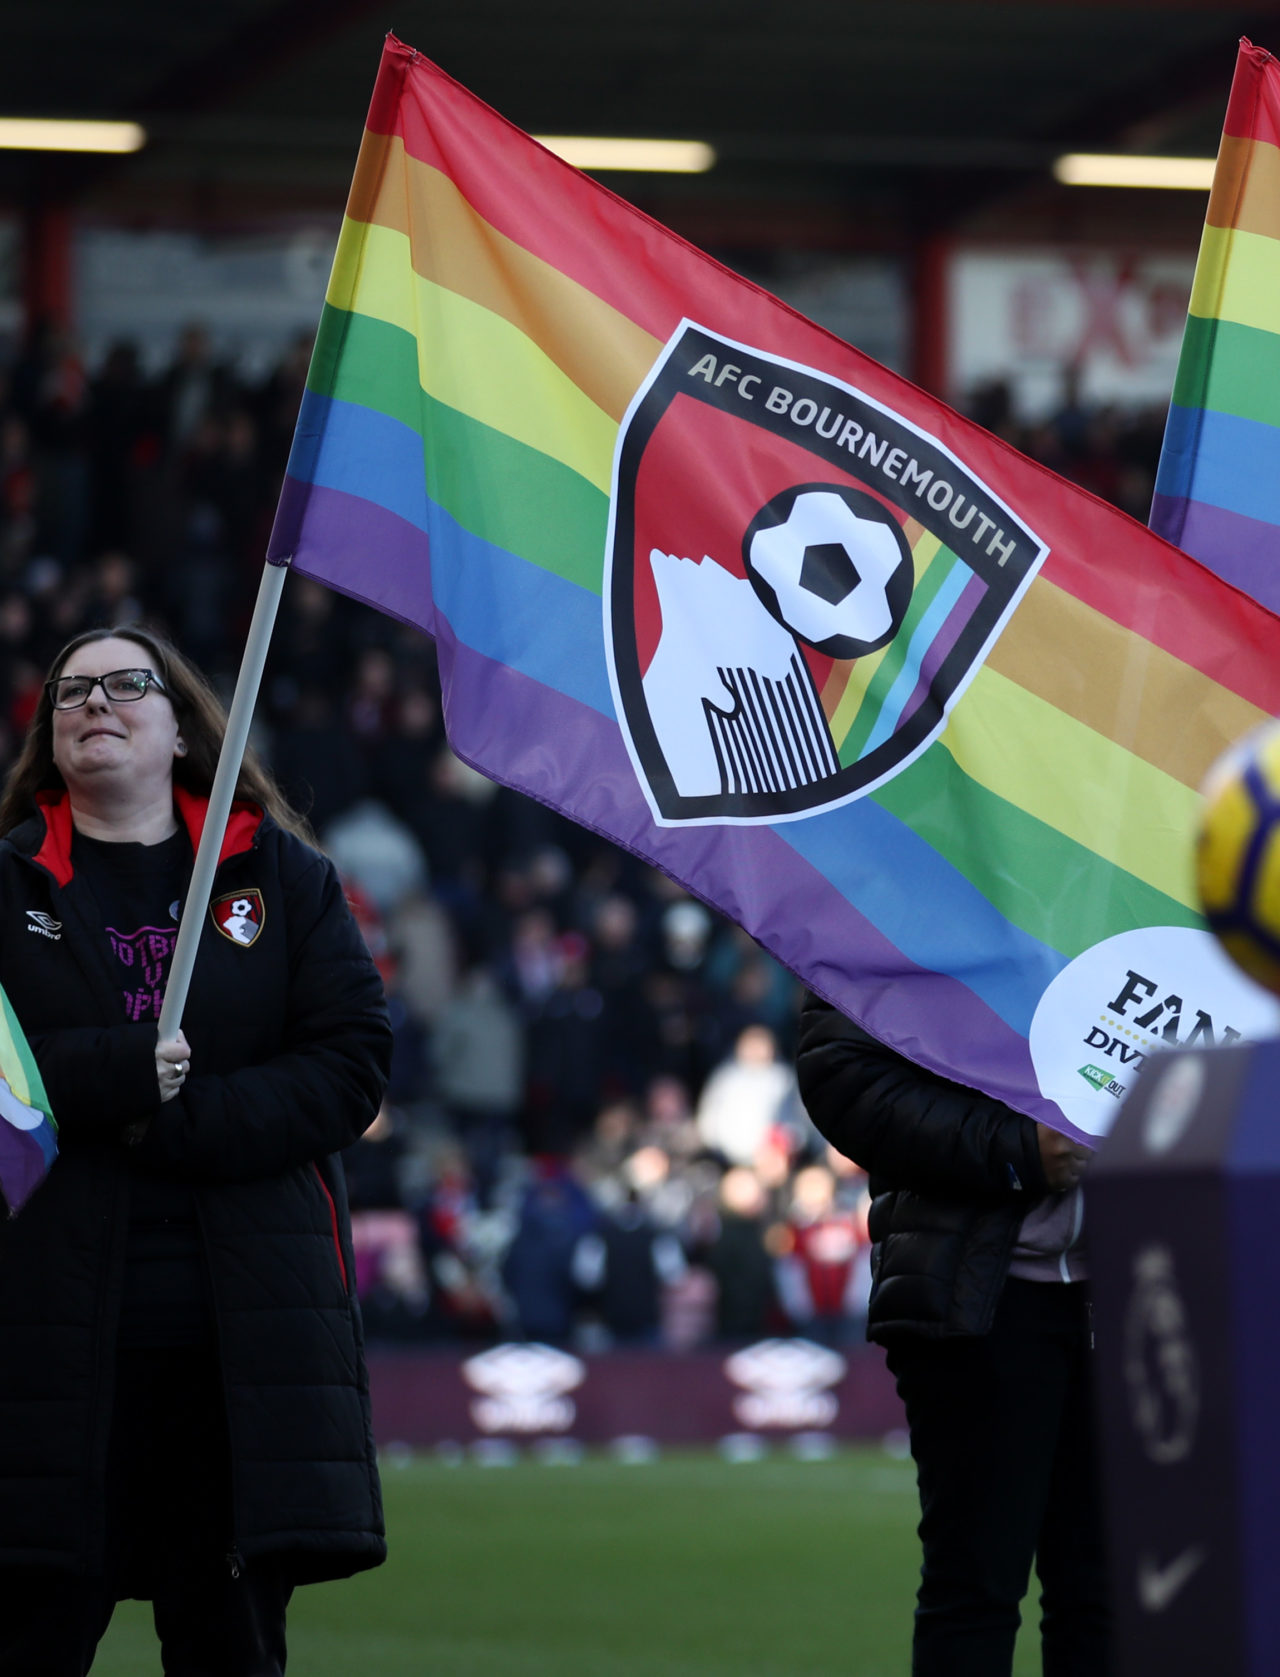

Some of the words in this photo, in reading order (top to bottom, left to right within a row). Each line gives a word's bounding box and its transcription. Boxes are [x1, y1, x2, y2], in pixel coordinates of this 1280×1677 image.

[687, 354, 762, 400] AFC
[764, 386, 1017, 568] BOURNEMOUTH
[27, 923, 62, 940] umbro
